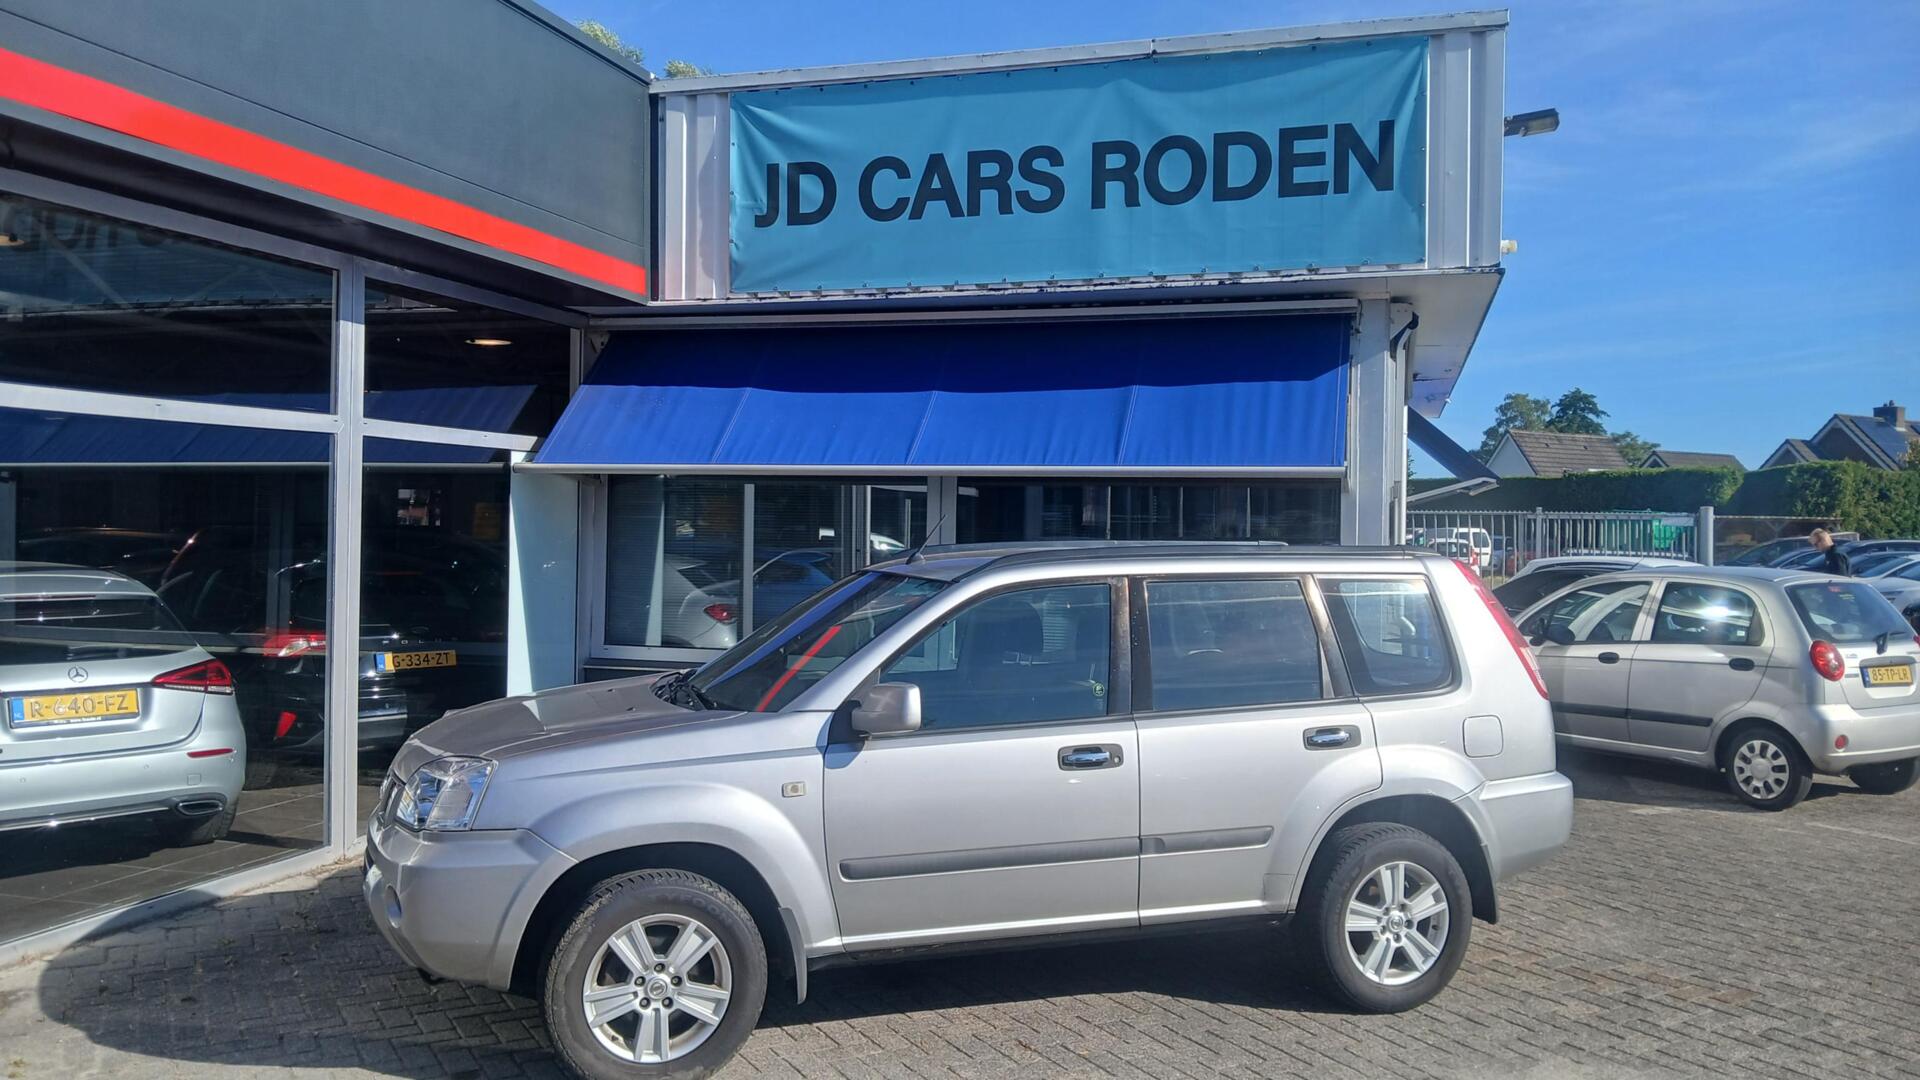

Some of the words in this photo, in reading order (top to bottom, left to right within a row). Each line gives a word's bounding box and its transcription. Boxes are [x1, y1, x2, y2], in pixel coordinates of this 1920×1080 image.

[754, 162, 838, 228] JD
[858, 145, 1065, 222] CARS
[1091, 119, 1395, 210] RODEN
[392, 652, 450, 667] G-334-ZT
[1871, 667, 1909, 681] 85-TP-LR
[30, 693, 129, 718] R-640-FZ
